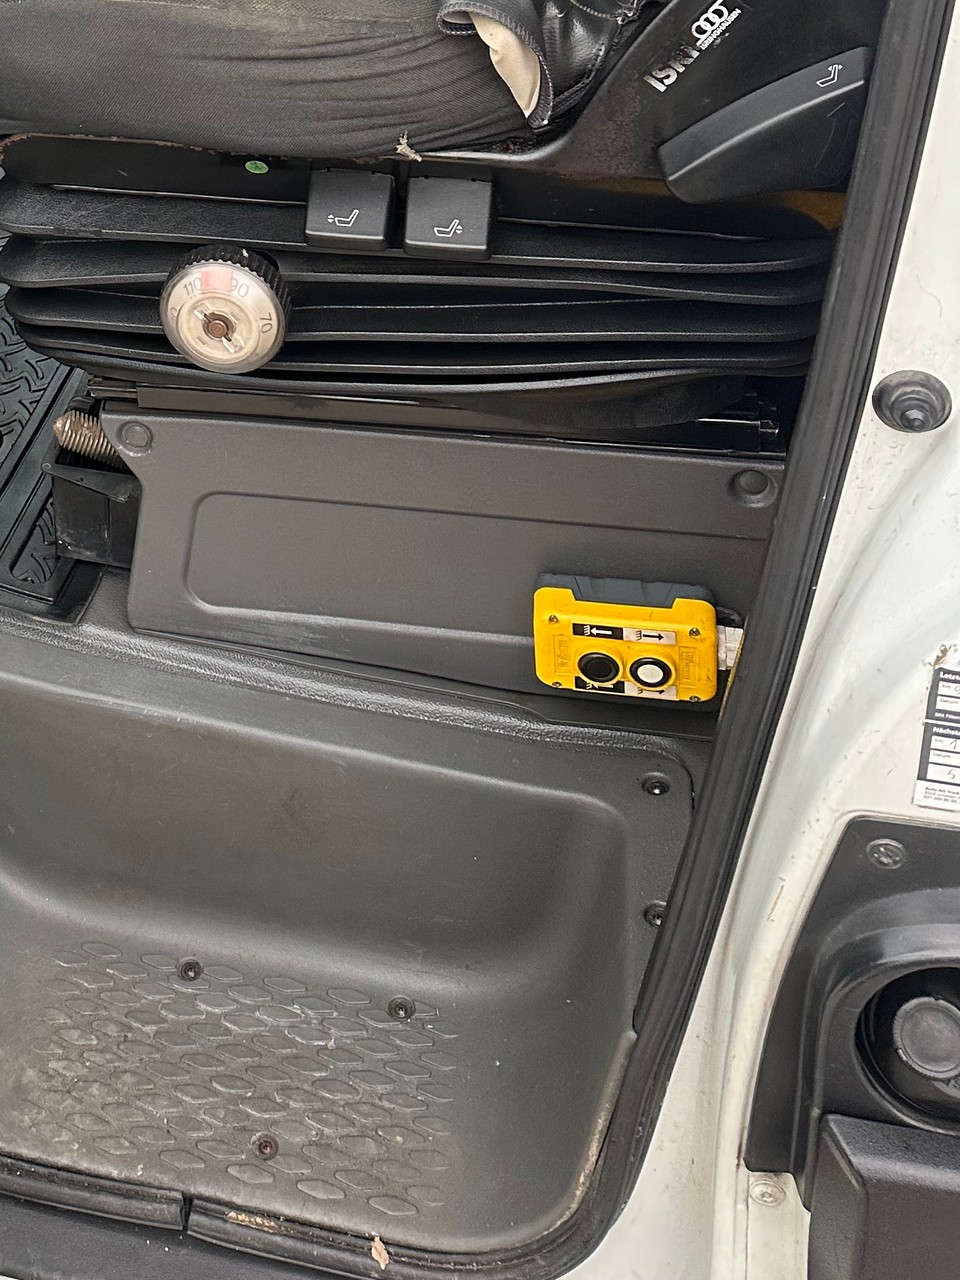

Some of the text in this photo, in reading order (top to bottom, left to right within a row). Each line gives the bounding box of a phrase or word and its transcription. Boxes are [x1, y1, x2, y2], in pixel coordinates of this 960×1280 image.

[183, 277, 203, 297] 110
[230, 277, 250, 298] 90
[259, 312, 273, 334] 70
